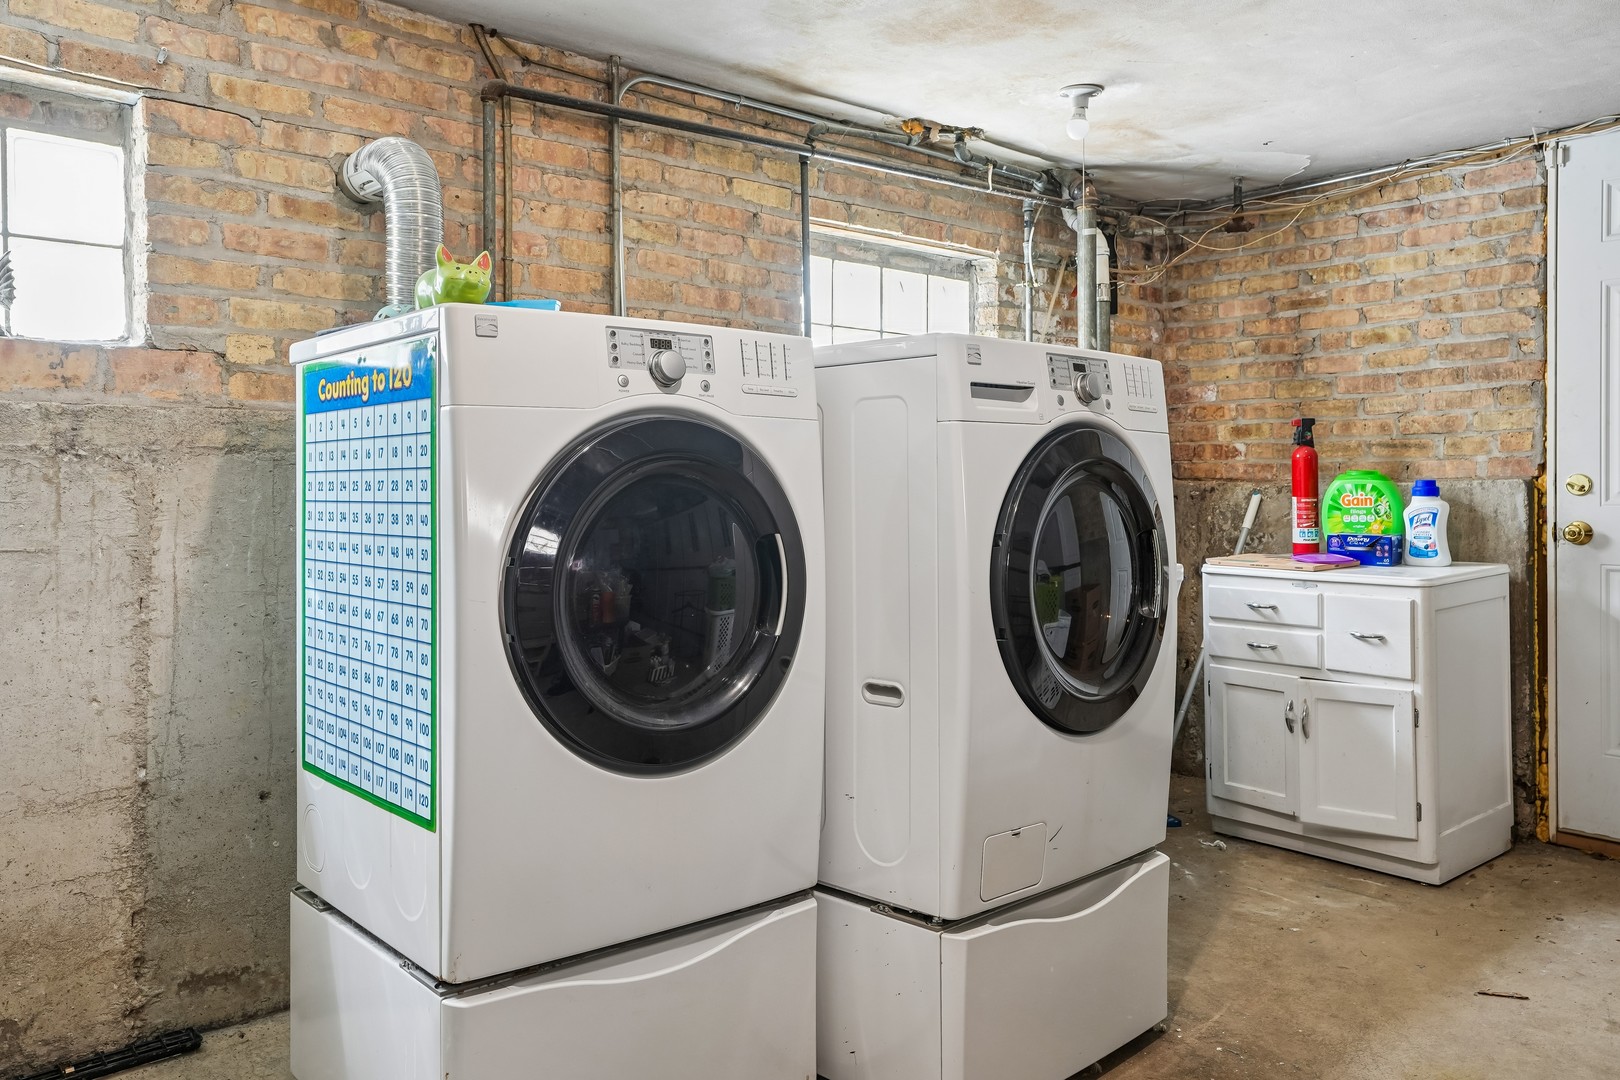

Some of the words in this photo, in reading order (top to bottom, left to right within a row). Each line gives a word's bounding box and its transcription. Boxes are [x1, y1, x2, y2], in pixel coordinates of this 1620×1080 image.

[318, 371, 370, 402] Counting
[372, 369, 386, 392] to
[389, 364, 413, 391] 120
[319, 422, 323, 432] 2
[330, 420, 334, 431] 3
[341, 419, 346, 430] 4
[354, 417, 358, 429] 5
[366, 416, 370, 428] 6
[378, 414, 383, 426] 7
[392, 412, 397, 425] 8
[406, 411, 412, 423] 9
[421, 409, 428, 422] 10
[308, 452, 312, 462] 11
[318, 451, 324, 462] 12
[328, 450, 334, 462] 13
[340, 450, 346, 461] 14
[352, 449, 358, 460] 15
[365, 448, 372, 460] 16
[378, 447, 384, 459] 17
[392, 446, 398, 458] 18
[406, 445, 412, 457] 19
[420, 444, 428, 457] 20
[308, 481, 312, 492] 21
[318, 481, 324, 492] 22
[328, 481, 334, 492] 23
[340, 480, 347, 492] 24
[352, 480, 359, 492] 25
[364, 480, 372, 492] 26
[377, 480, 384, 492] 27
[391, 480, 399, 492] 28
[406, 480, 413, 492] 29
[420, 479, 428, 492] 30
[1341, 493, 1373, 507] Gain
[307, 510, 312, 521] 31
[317, 510, 324, 522] 32
[328, 511, 334, 522] 33
[339, 512, 347, 522] 34
[352, 512, 359, 523] 35
[364, 512, 372, 524] 36
[377, 512, 384, 524] 37
[391, 513, 399, 525] 38
[406, 514, 414, 526] 39
[420, 514, 428, 527] 40
[1415, 514, 1431, 524] Lysol
[307, 539, 312, 550] 41
[317, 540, 324, 551] 42
[328, 541, 334, 552] 43
[339, 542, 347, 553] 44
[352, 543, 359, 554] 45
[364, 544, 372, 556] 46
[376, 545, 385, 556] 47
[390, 546, 400, 558] 48
[405, 547, 414, 560] 49
[420, 548, 428, 561] 50
[307, 568, 312, 578] 51
[317, 569, 324, 580] 52
[328, 571, 334, 582] 53
[339, 572, 347, 584] 54
[352, 574, 359, 586] 55
[364, 576, 372, 588] 56
[377, 577, 384, 589] 57
[391, 579, 399, 592] 58
[406, 581, 414, 594] 59
[420, 583, 429, 596] 60
[307, 598, 312, 608] 61
[317, 599, 324, 610] 62
[328, 602, 334, 613] 63
[339, 604, 347, 614] 64
[352, 606, 358, 618] 65
[364, 608, 372, 620] 66
[376, 610, 384, 622] 67
[390, 613, 399, 625] 68
[406, 616, 414, 628] 69
[420, 618, 428, 631] 70
[307, 626, 312, 637] 71
[317, 628, 324, 640] 72
[328, 631, 334, 643] 73
[339, 634, 346, 646] 74
[352, 637, 358, 649] 75
[364, 640, 372, 652] 76
[376, 643, 384, 655] 77
[390, 646, 399, 659] 78
[406, 649, 414, 662] 79
[420, 653, 428, 666] 80
[307, 655, 312, 666] 81
[317, 658, 323, 670] 82
[327, 662, 334, 673] 83
[339, 664, 346, 676] 84
[352, 668, 358, 680] 85
[364, 672, 371, 684] 86
[376, 675, 384, 688] 87
[390, 679, 398, 692] 88
[405, 683, 414, 696] 89
[420, 687, 428, 701] 90
[307, 684, 312, 696] 91
[317, 688, 323, 700] 92
[327, 692, 334, 704] 93
[339, 696, 346, 708] 94
[352, 700, 358, 712] 95
[364, 704, 371, 716] 96
[376, 708, 384, 720] 97
[390, 713, 398, 726] 98
[405, 718, 413, 731] 99
[419, 722, 430, 737] 100
[326, 722, 334, 735] 103
[338, 728, 347, 740] 104
[350, 732, 359, 745] 105
[363, 736, 372, 750] 106
[376, 742, 385, 755] 107
[389, 746, 400, 761] 108
[404, 752, 414, 766] 109
[420, 758, 429, 772] 110
[338, 758, 346, 771] 114
[363, 769, 371, 782] 116
[376, 775, 384, 788] 117
[389, 780, 398, 795] 118
[404, 787, 413, 801] 119
[418, 793, 429, 808] 120
